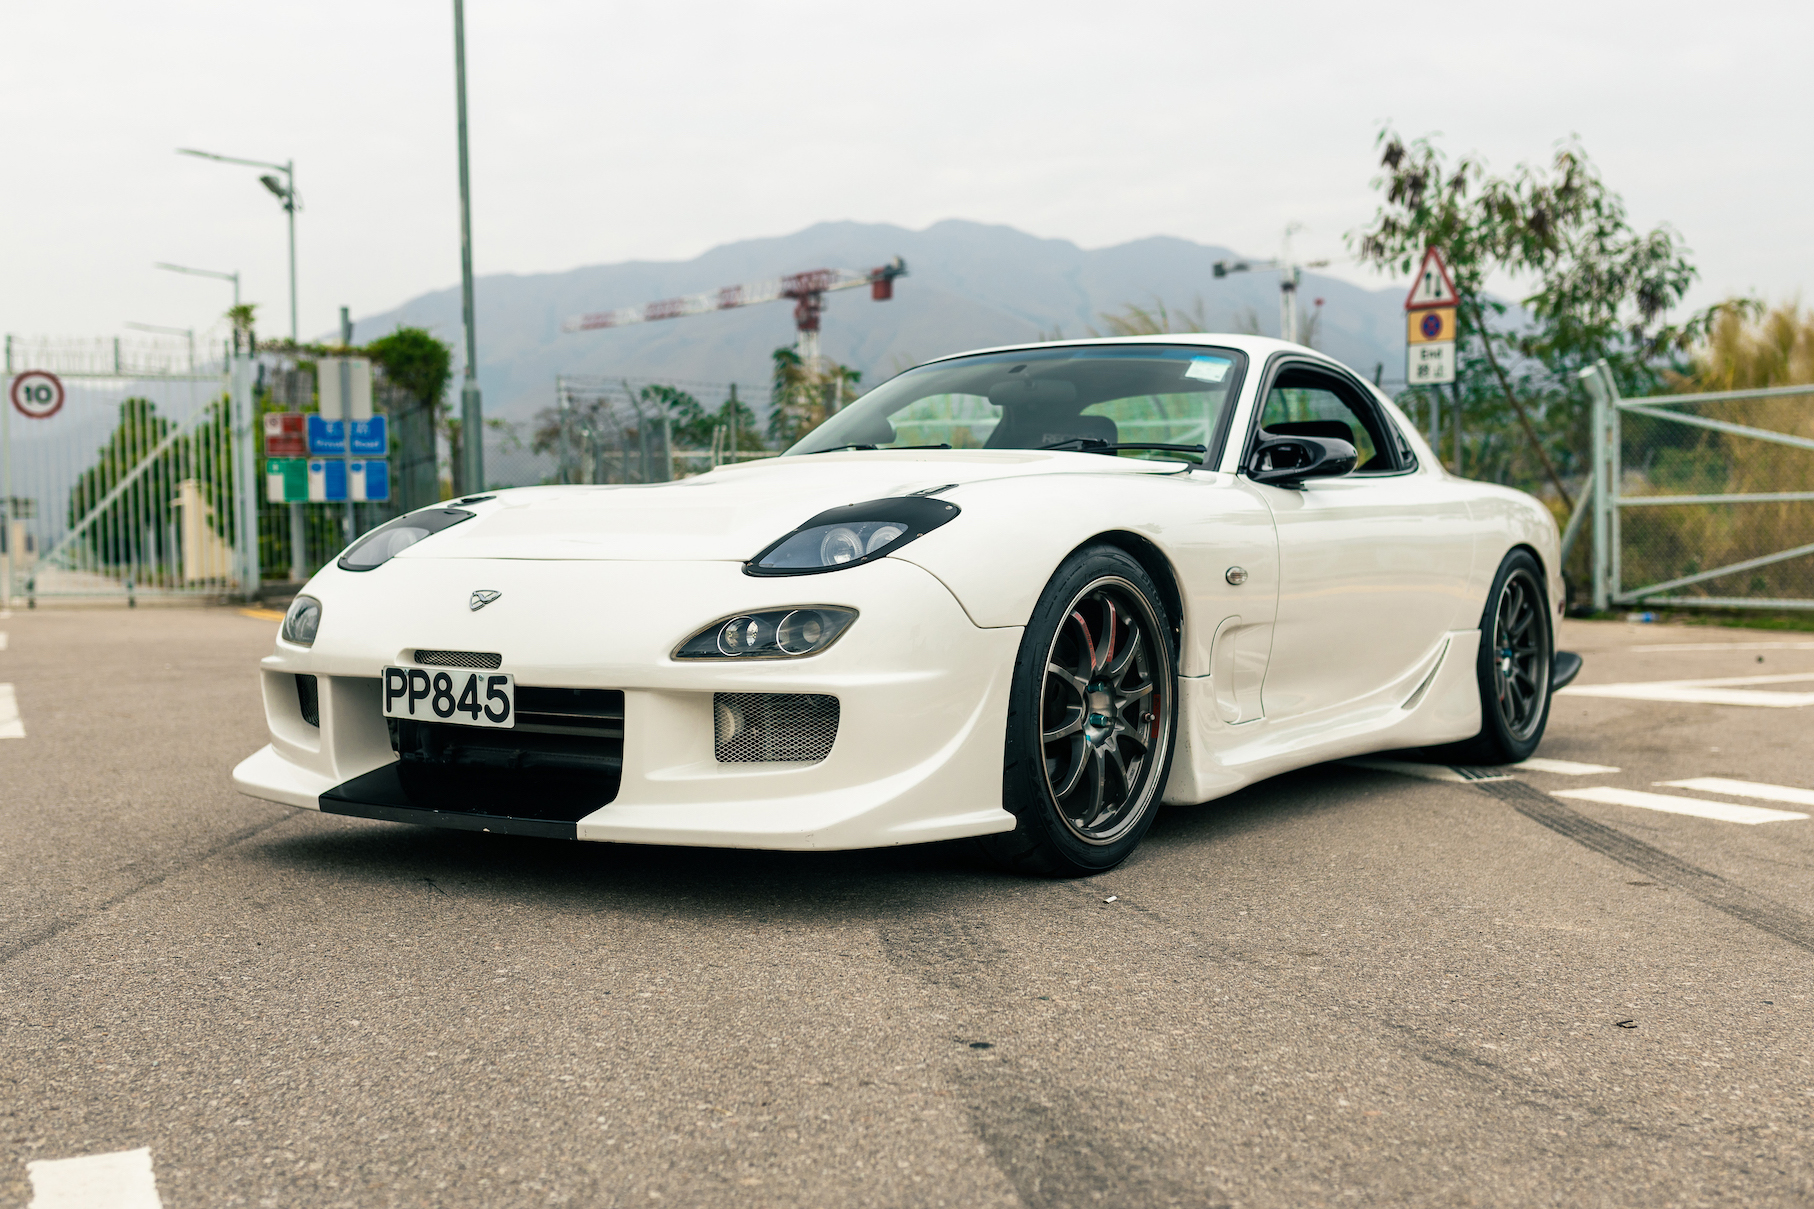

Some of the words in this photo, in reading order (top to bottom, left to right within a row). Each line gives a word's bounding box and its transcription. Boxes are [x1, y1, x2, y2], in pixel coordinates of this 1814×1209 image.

[1421, 348, 1443, 360] End
[24, 385, 52, 405] 10
[386, 667, 510, 723] PP845
